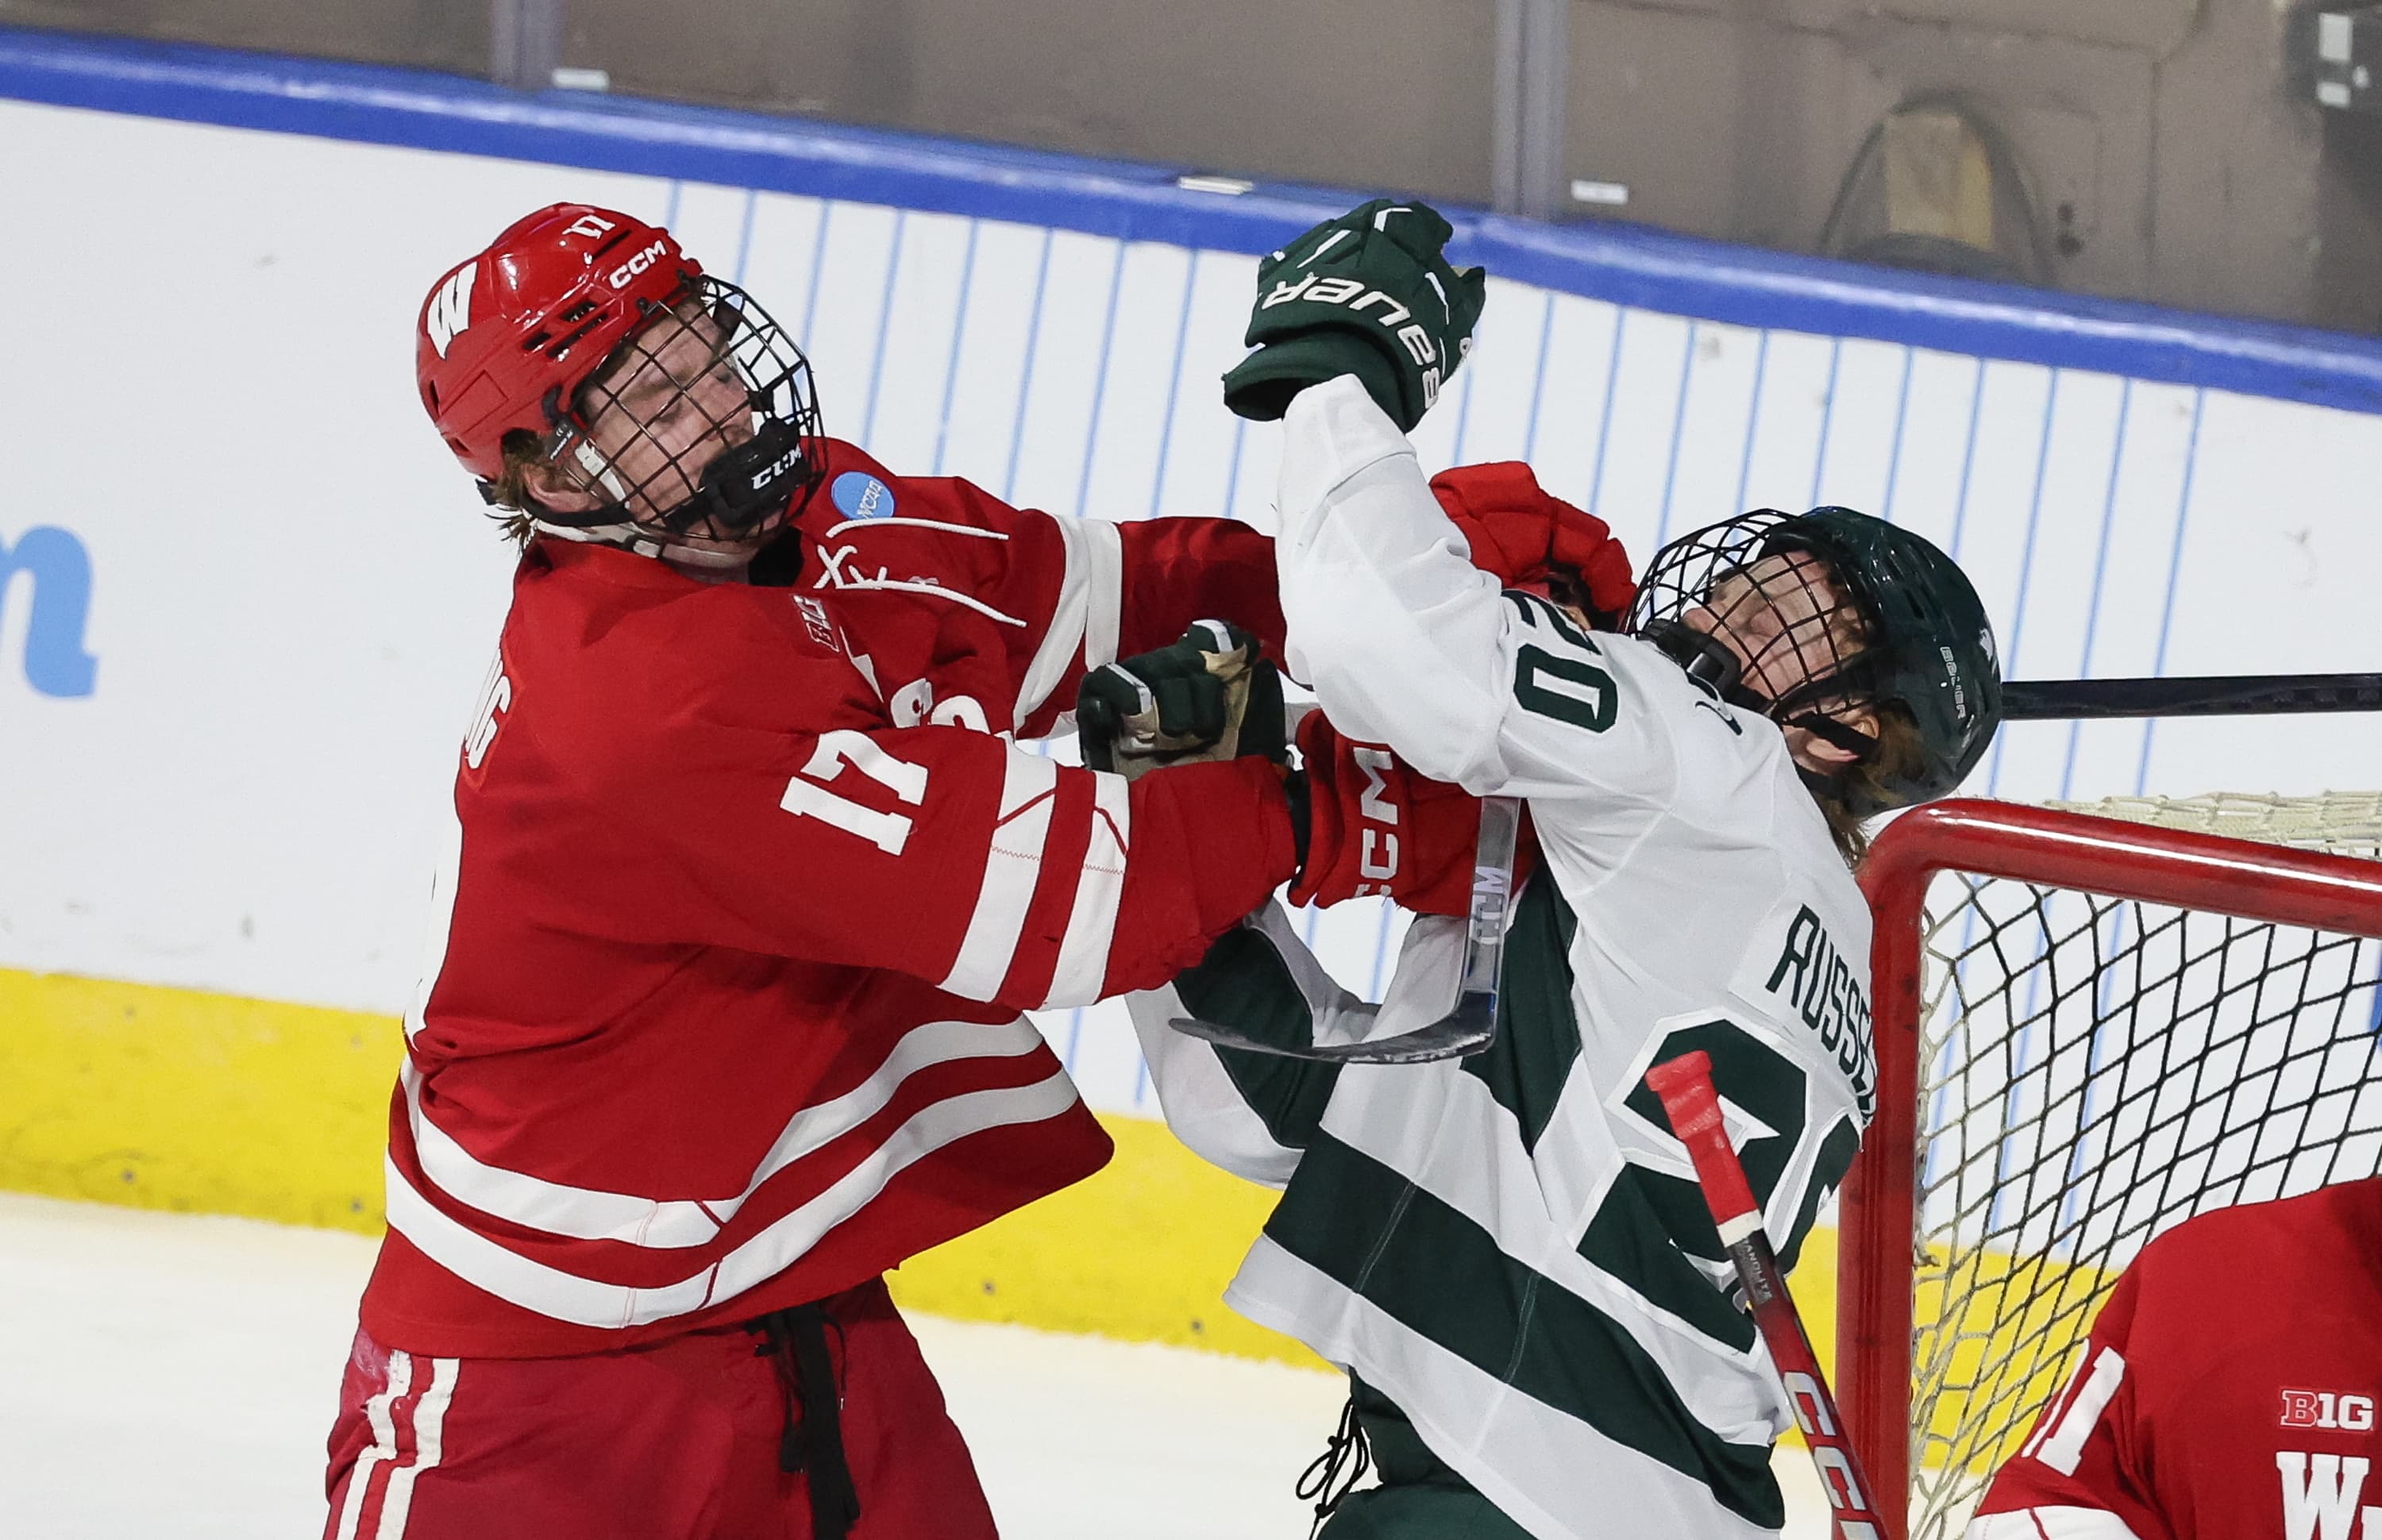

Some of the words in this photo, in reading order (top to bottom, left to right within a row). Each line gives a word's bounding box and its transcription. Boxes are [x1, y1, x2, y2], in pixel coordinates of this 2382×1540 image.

[427, 260, 478, 360] W
[609, 240, 667, 289] CCM
[779, 729, 929, 857] 17
